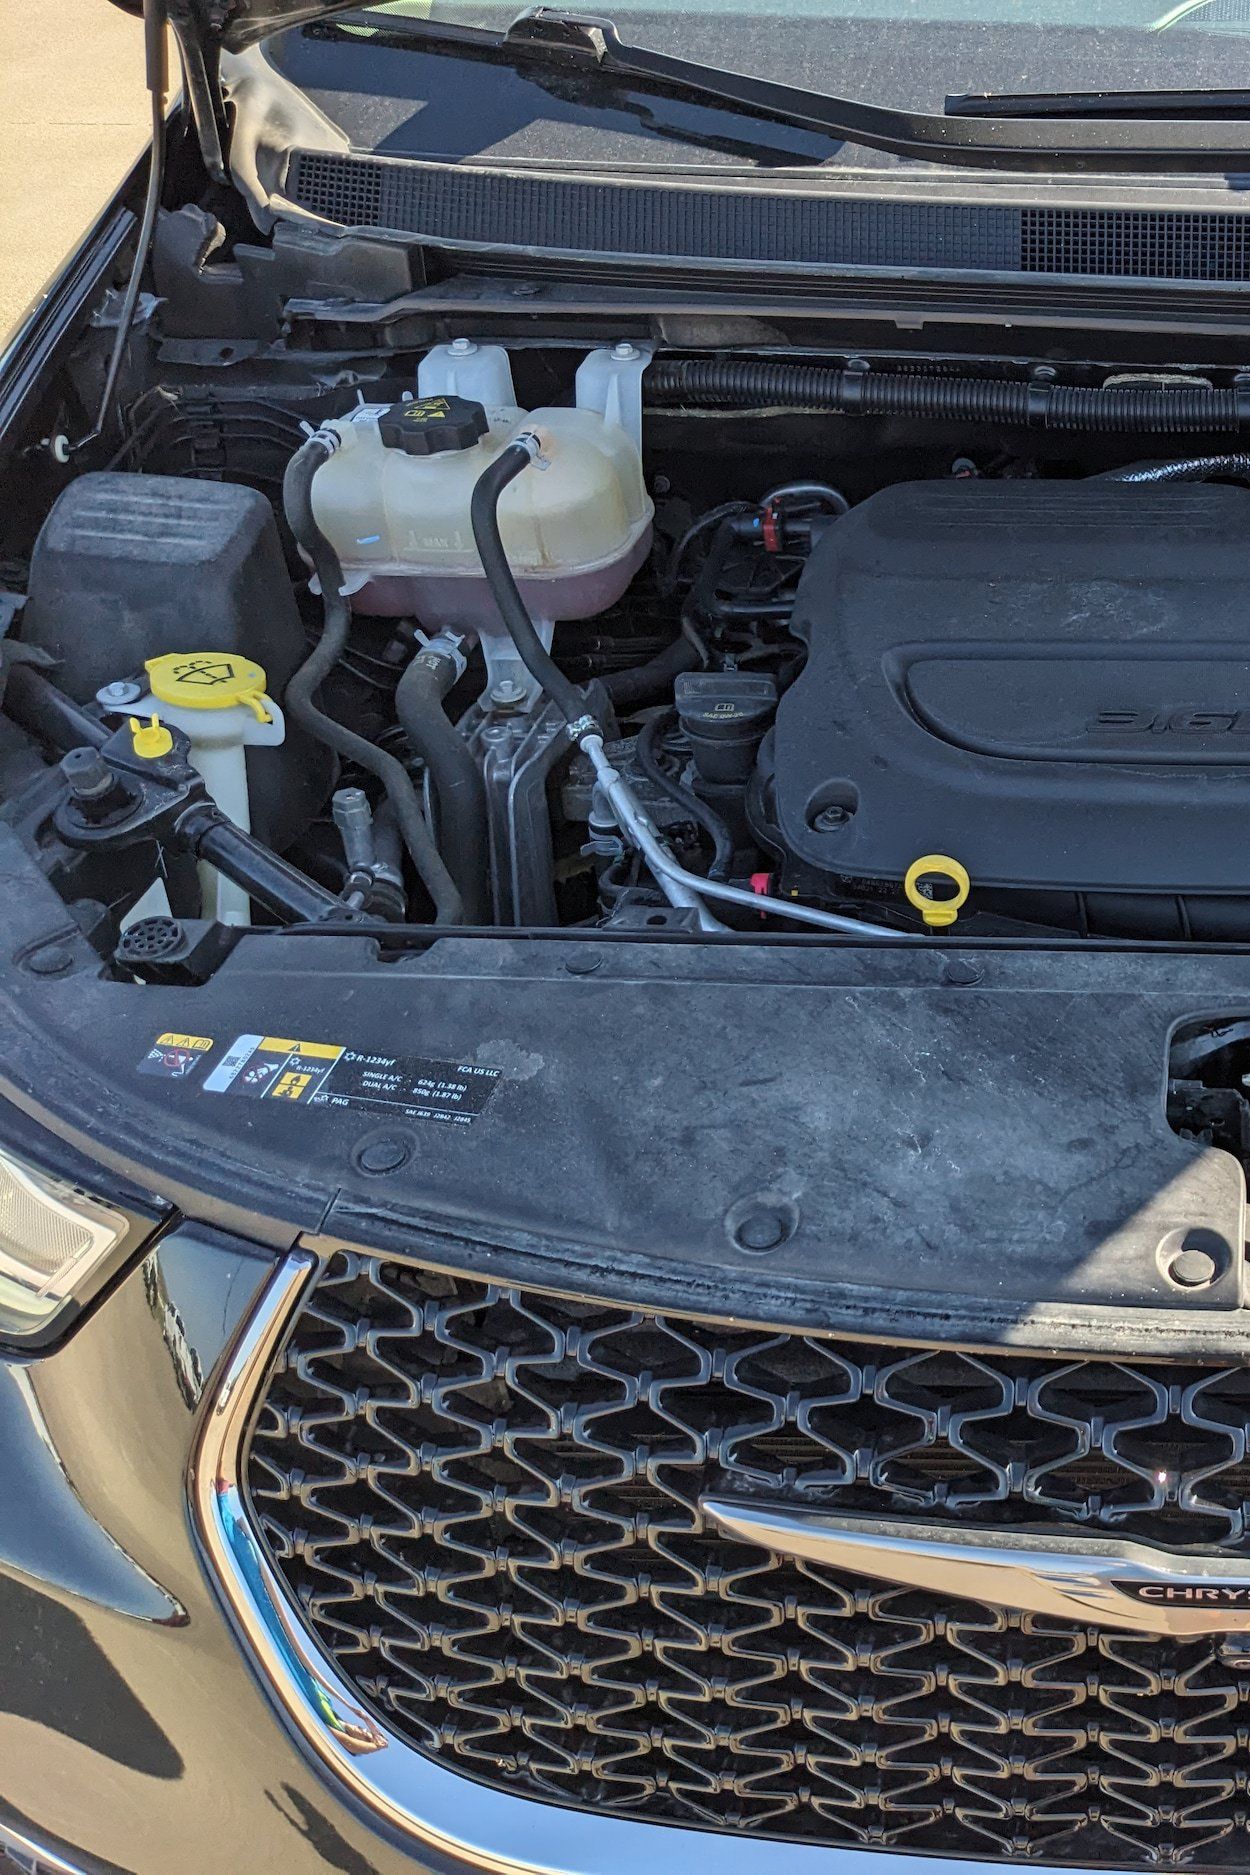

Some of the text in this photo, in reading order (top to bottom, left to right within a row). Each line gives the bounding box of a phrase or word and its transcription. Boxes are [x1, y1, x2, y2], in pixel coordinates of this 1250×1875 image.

[356, 1054, 397, 1067] R-1234yf
[457, 1065, 473, 1074] FCA
[474, 1068, 485, 1076] US
[362, 1071, 389, 1080] SINGLE
[362, 1080, 381, 1088] DUAL
[331, 1097, 350, 1106] PAG
